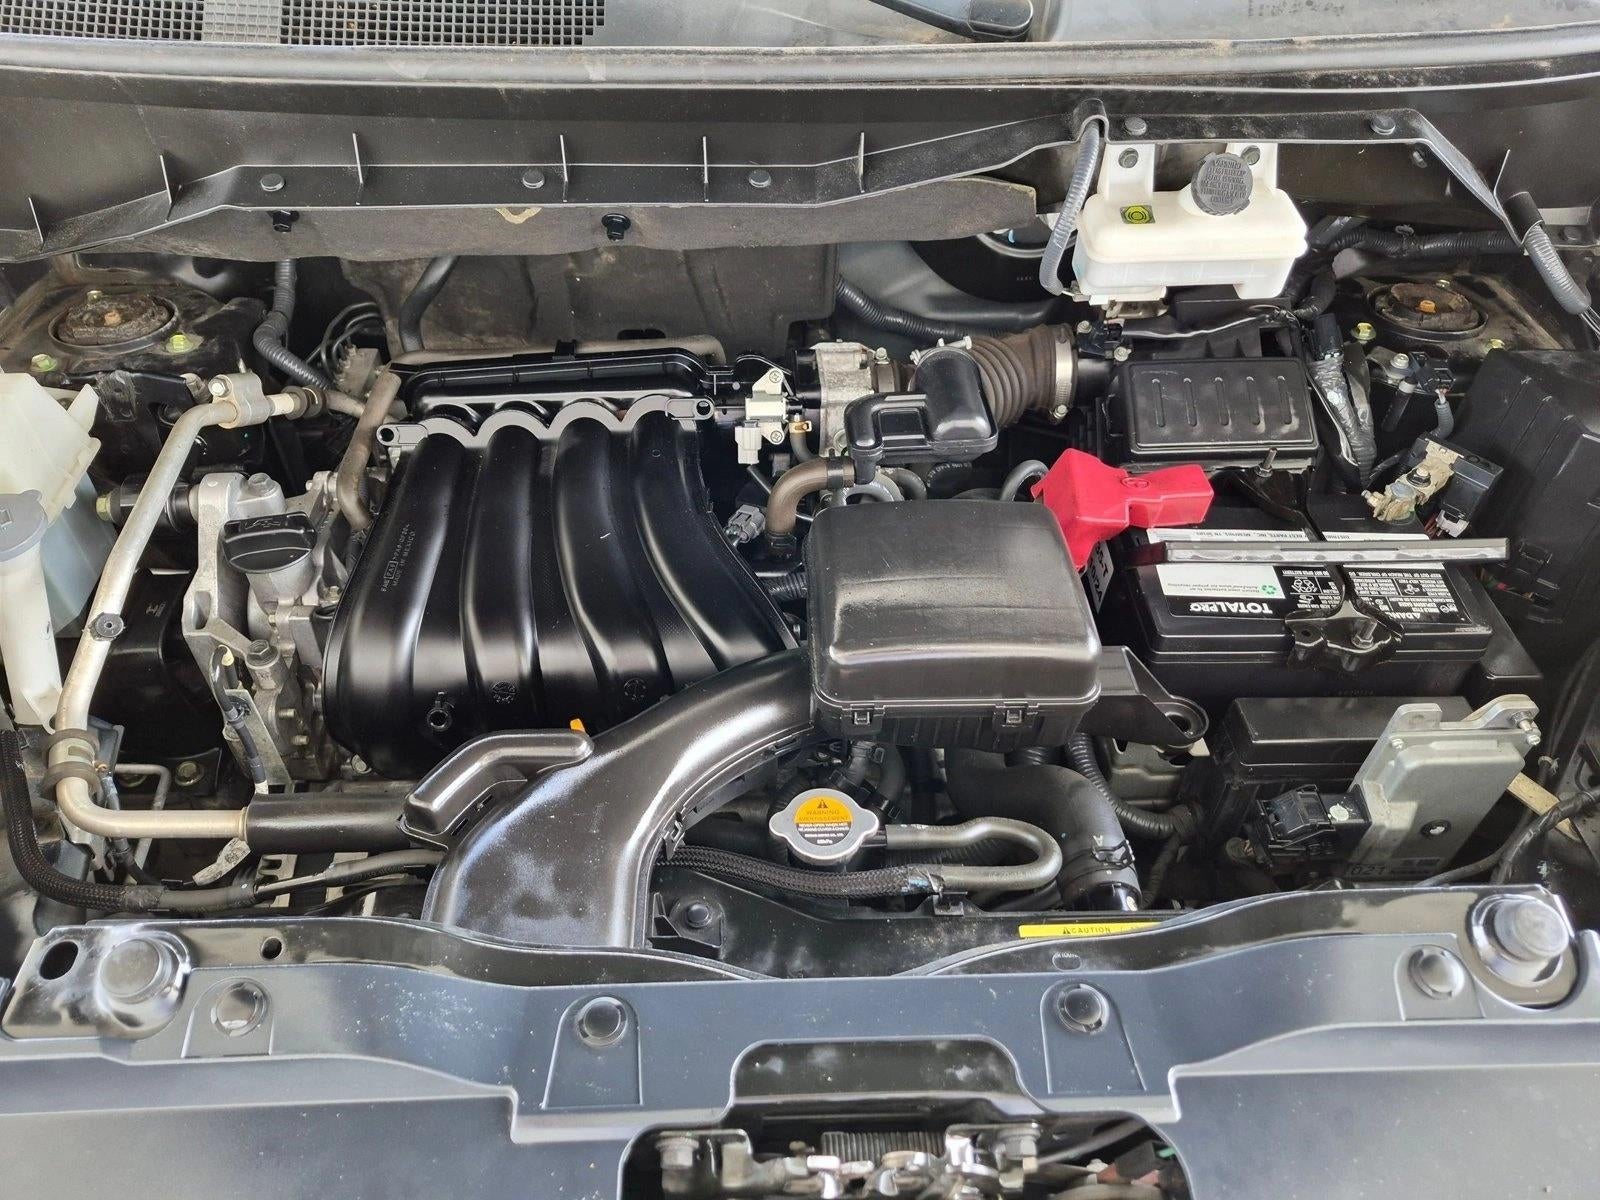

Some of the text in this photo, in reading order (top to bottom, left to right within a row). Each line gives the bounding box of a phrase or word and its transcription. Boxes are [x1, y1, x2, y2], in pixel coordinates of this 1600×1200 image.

[403, 531, 416, 557] MEXICO
[1189, 601, 1273, 614] TOTALPRO
[1071, 926, 1111, 934] CAUTION
